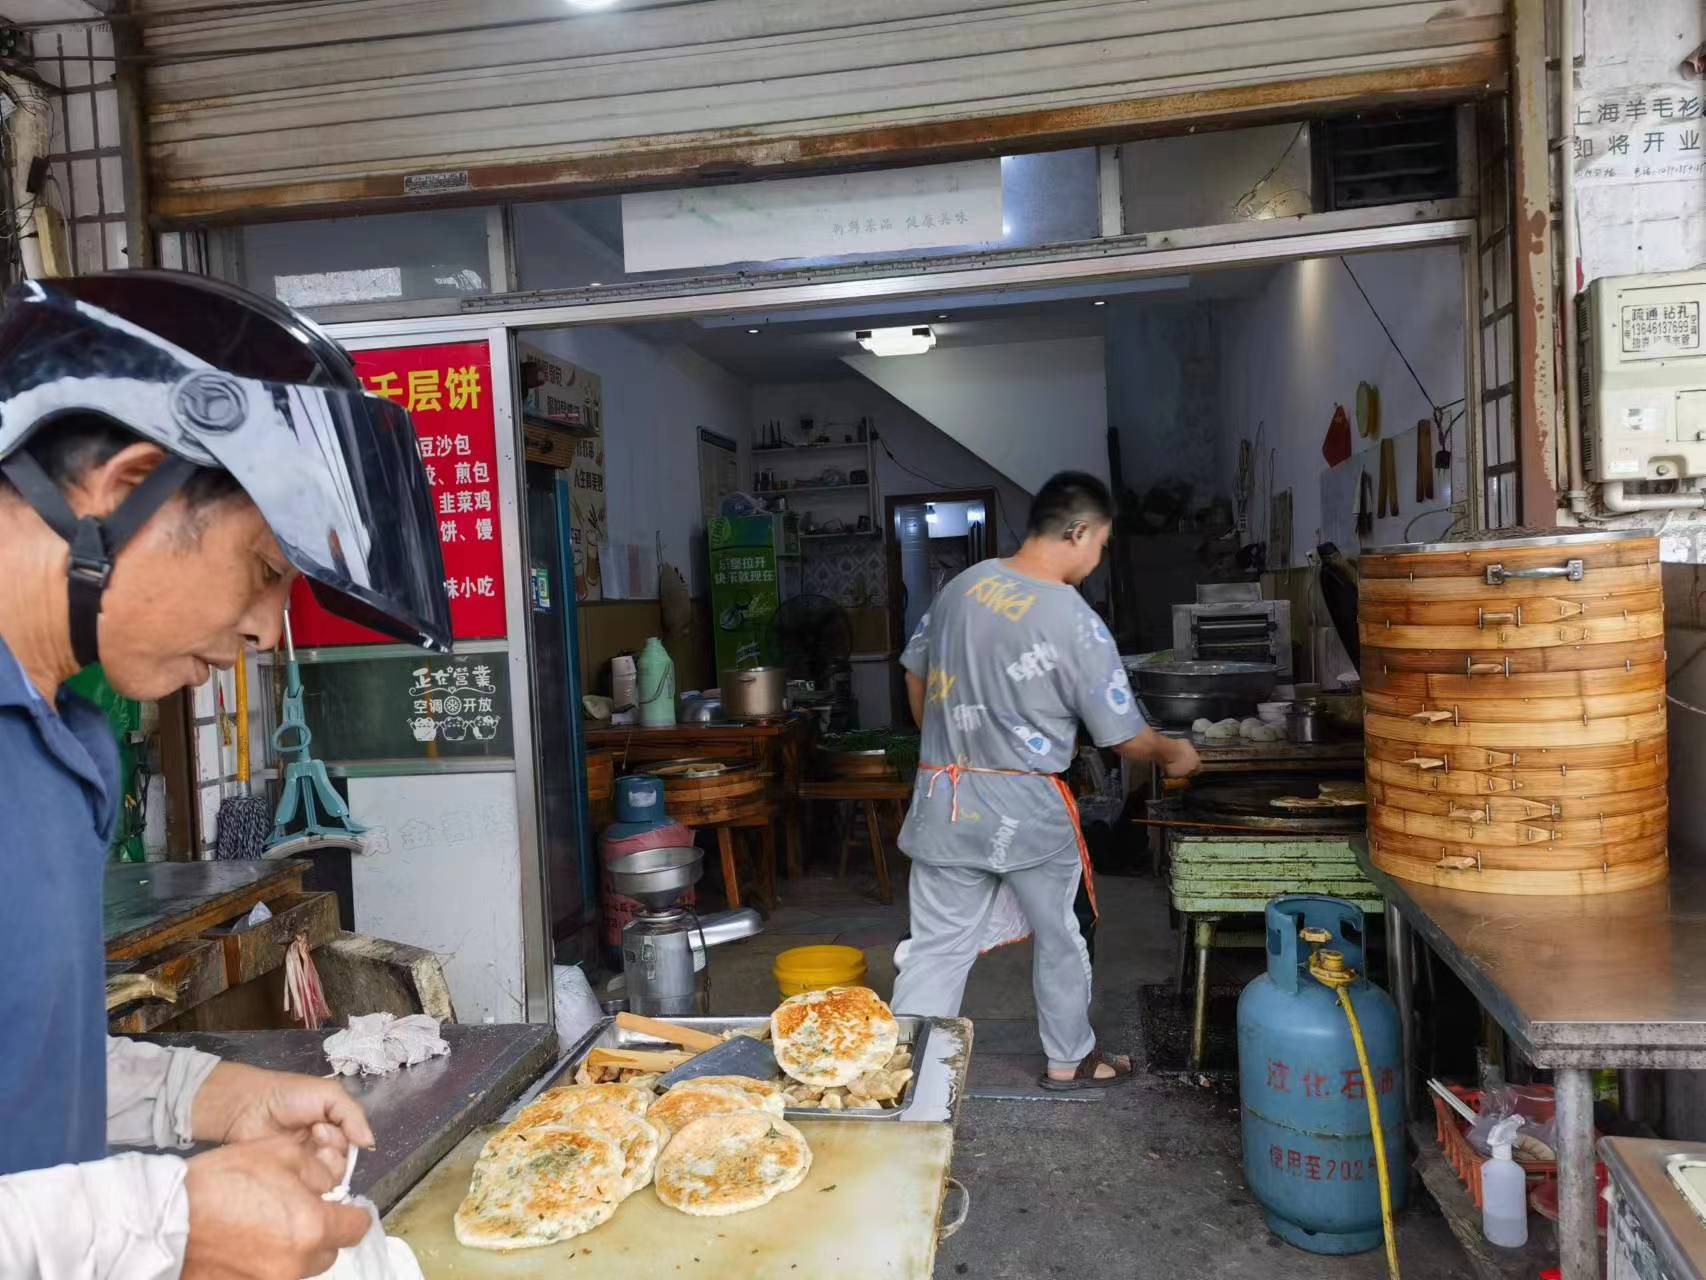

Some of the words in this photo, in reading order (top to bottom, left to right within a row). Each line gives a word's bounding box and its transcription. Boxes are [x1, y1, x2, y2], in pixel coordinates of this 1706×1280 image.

[1574, 96, 1700, 126] 上海羊毛衫
[359, 366, 482, 412] 千层饼
[418, 433, 472, 458] 豆沙包
[438, 489, 492, 514] 韭菜鸡
[440, 518, 494, 542] 饼、馒
[413, 699, 443, 714] 空调
[463, 697, 492, 713] 开放
